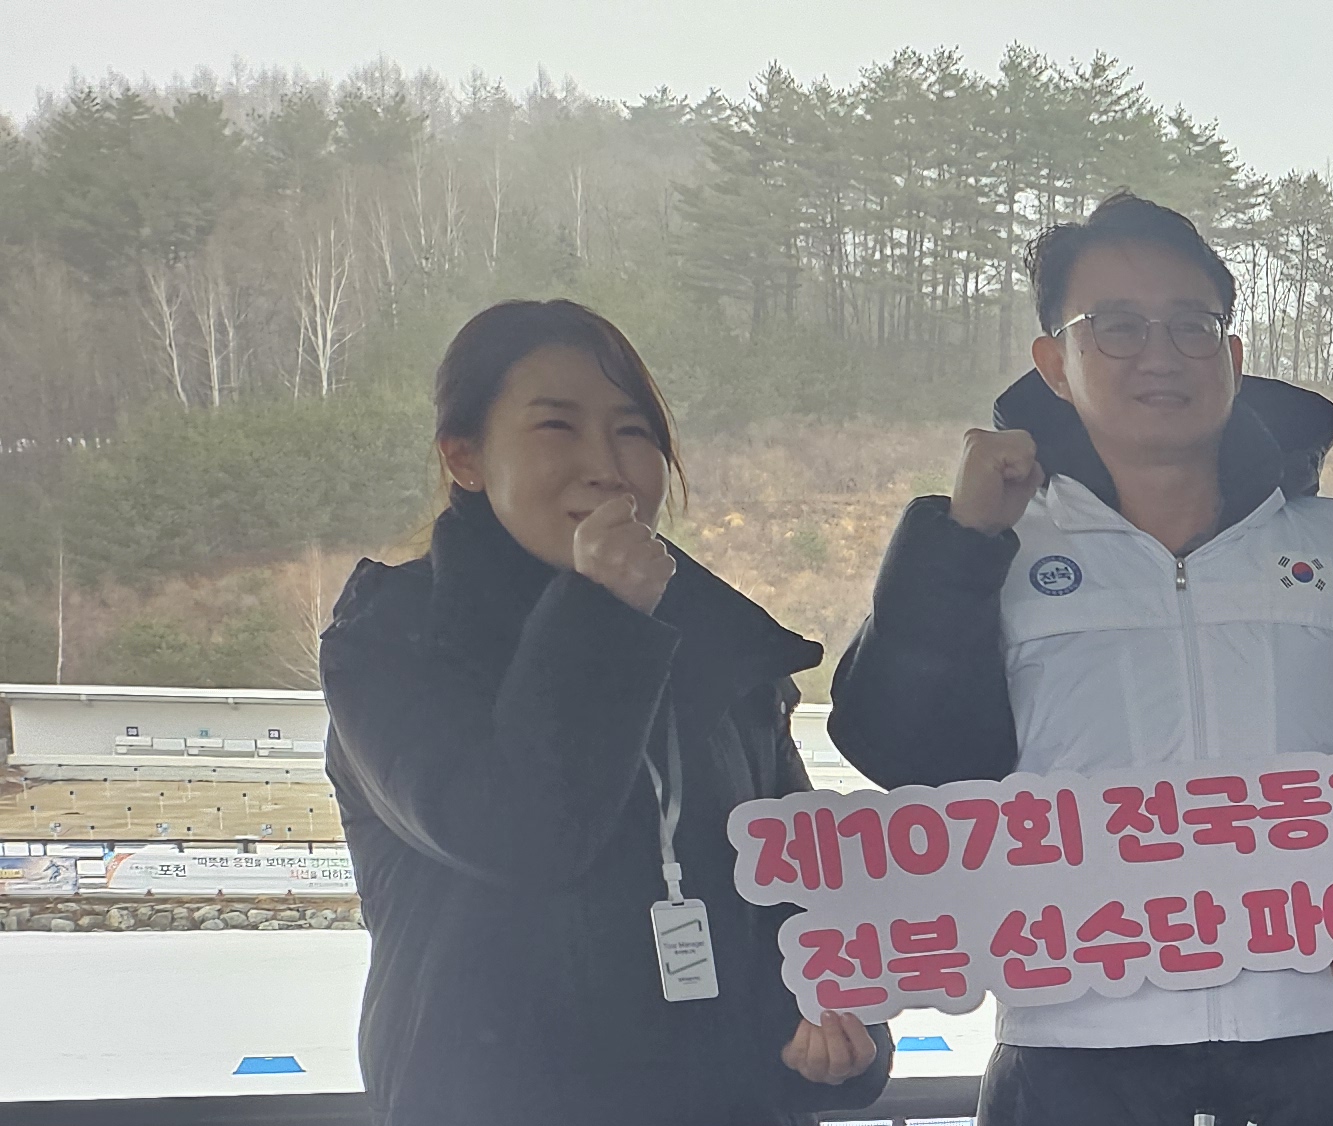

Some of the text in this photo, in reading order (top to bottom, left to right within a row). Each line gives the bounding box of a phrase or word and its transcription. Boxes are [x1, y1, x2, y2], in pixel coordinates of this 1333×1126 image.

[158, 864, 187, 878] 포천
[749, 789, 1083, 892] 제107회
[800, 915, 971, 1010] 전북
[989, 896, 1226, 993] 선수단
